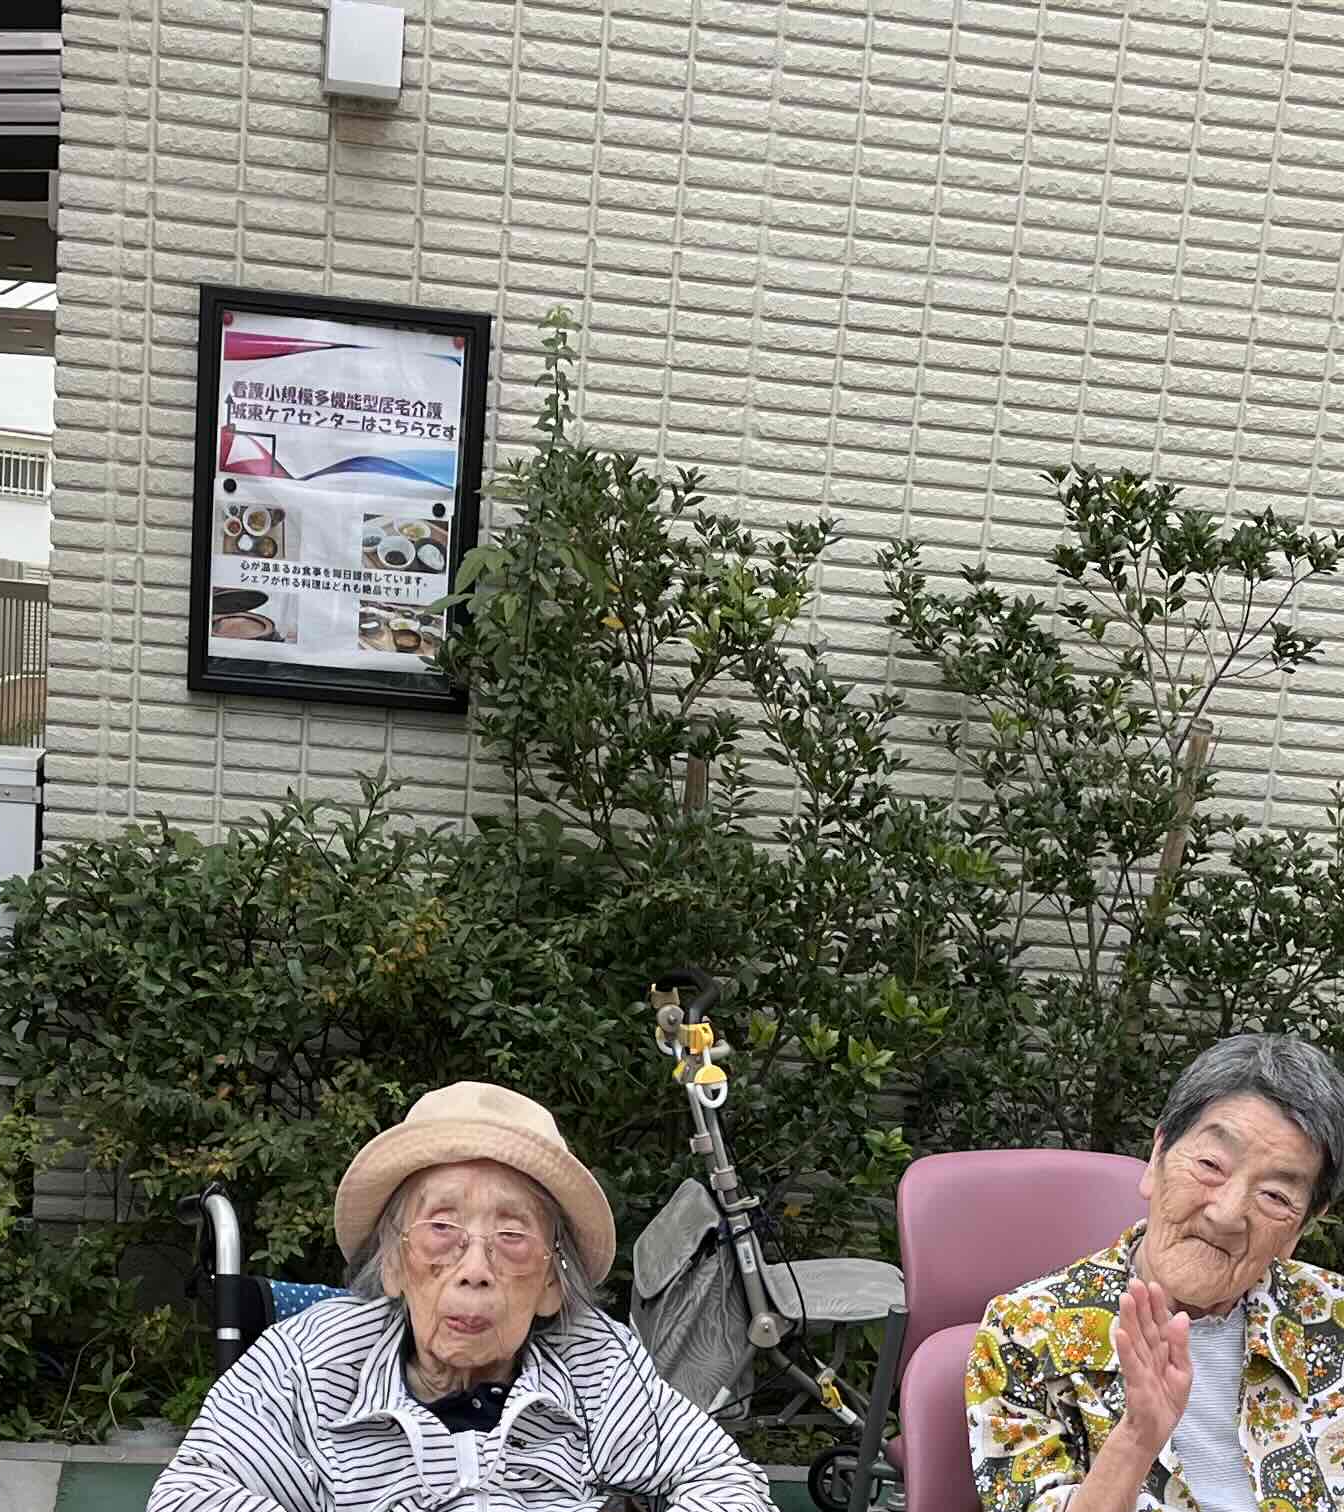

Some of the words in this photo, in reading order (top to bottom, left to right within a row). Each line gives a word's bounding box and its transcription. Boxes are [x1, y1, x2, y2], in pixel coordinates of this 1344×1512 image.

[232, 380, 443, 420] 看護小規模多機能型居宅介護
[231, 401, 458, 441] 城東ケアセンターはこちらです
